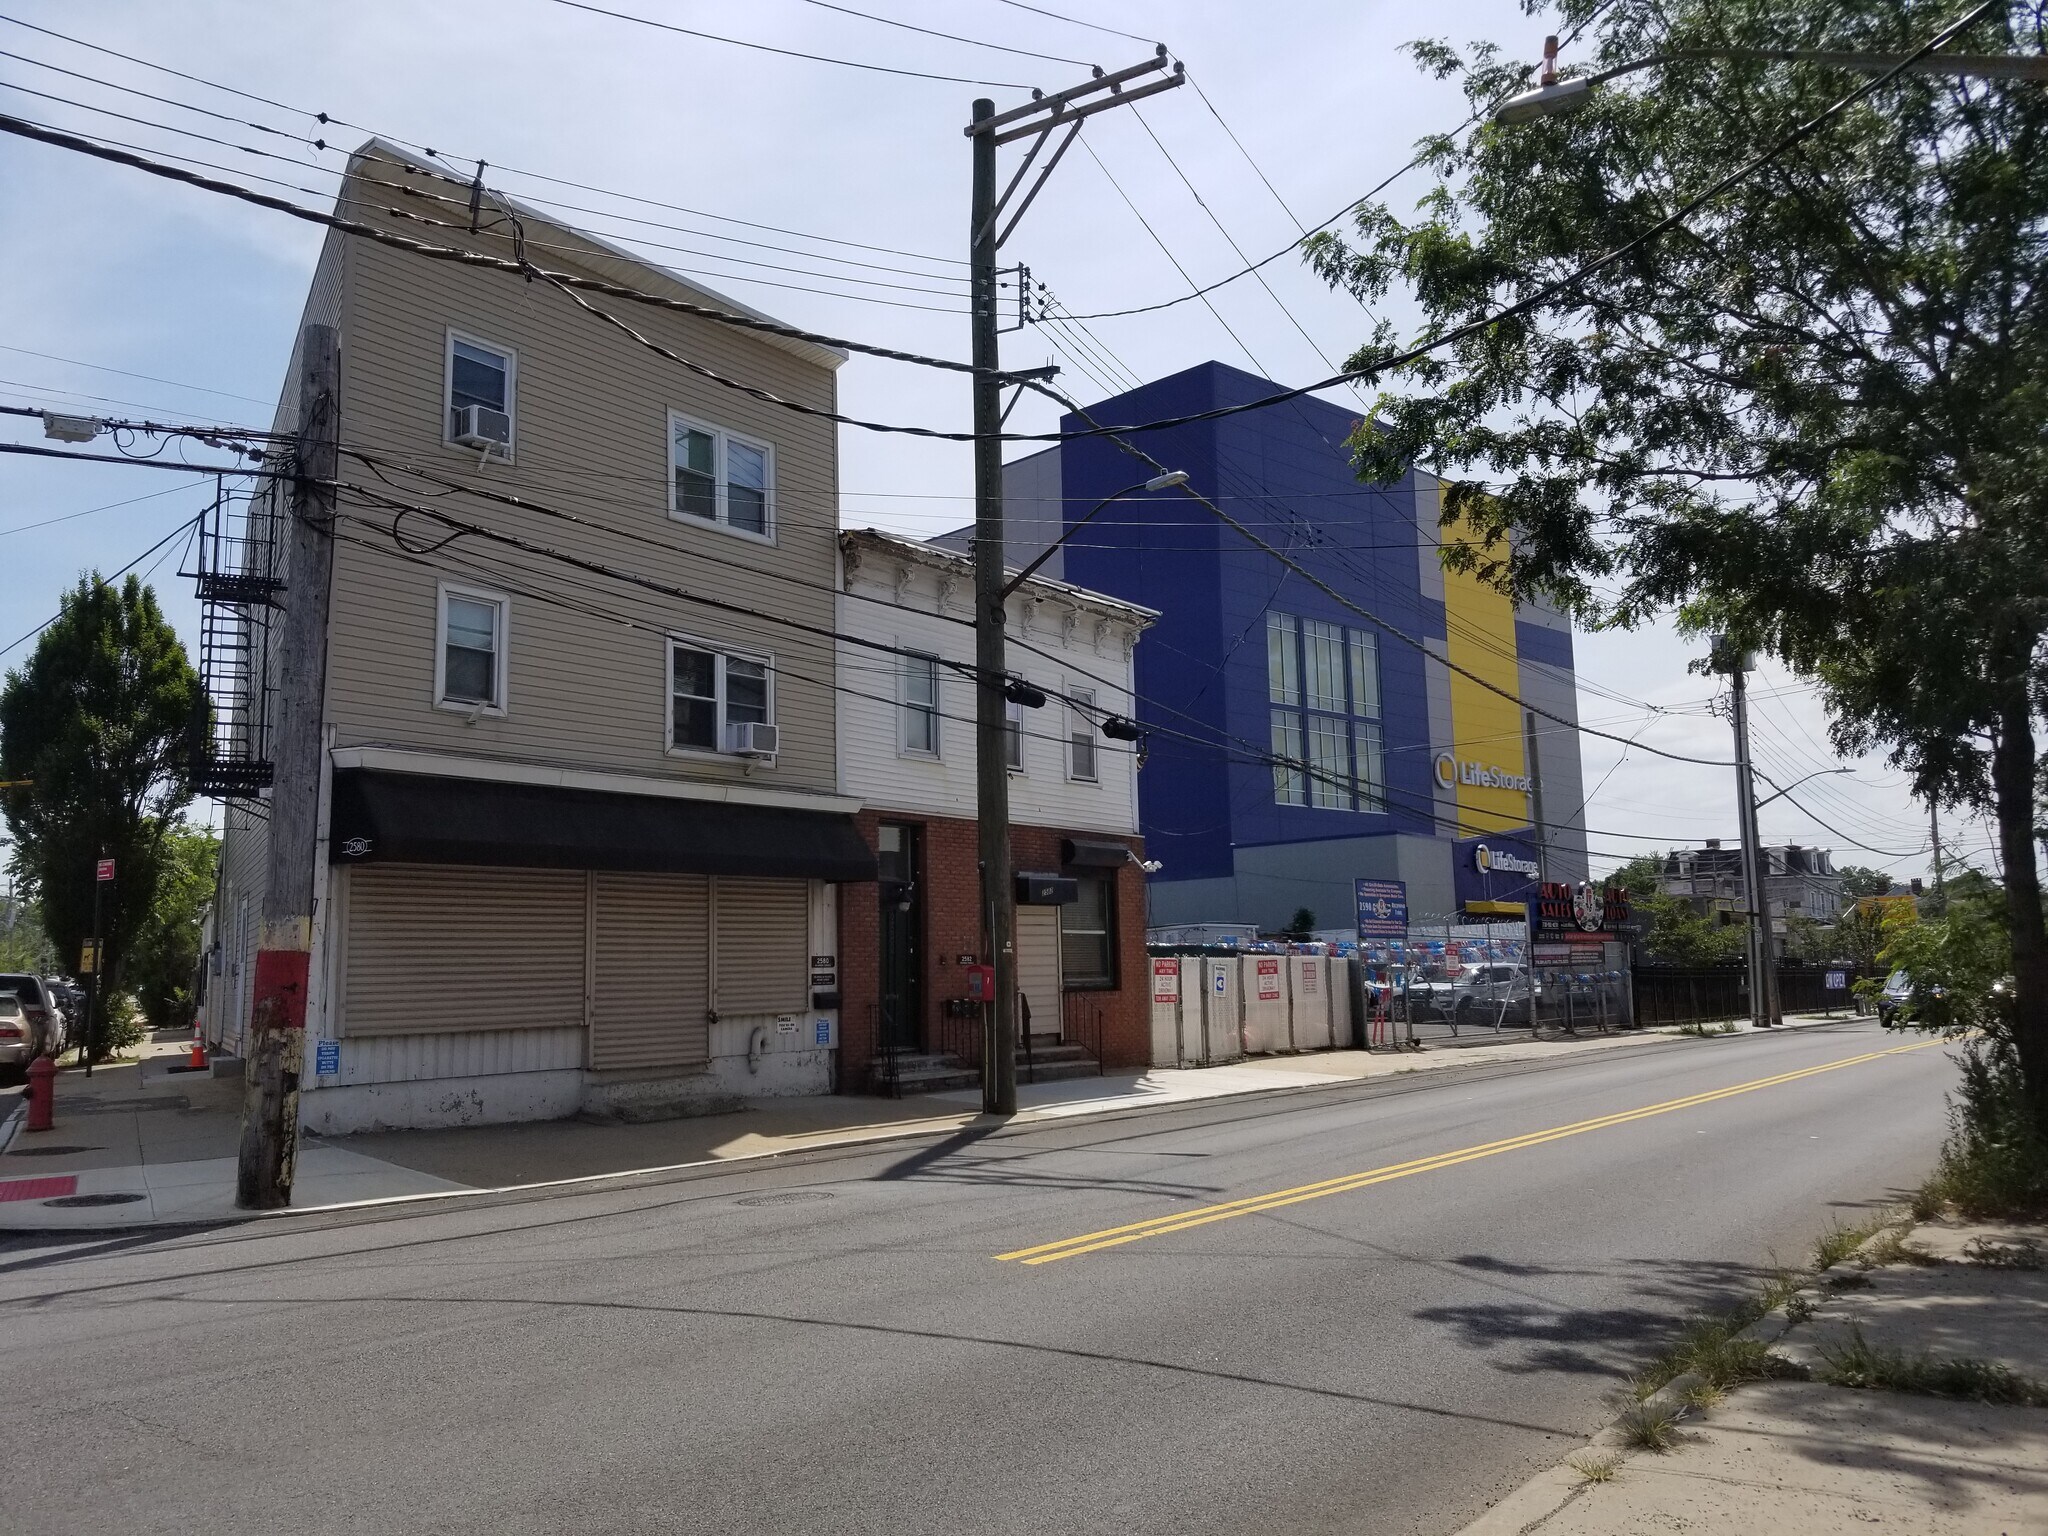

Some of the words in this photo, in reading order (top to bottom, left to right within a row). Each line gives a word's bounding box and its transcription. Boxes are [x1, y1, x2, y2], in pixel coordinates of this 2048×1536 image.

[1461, 761, 1543, 797] LifeStorag
[350, 842, 365, 851] 2580
[1541, 882, 1572, 899] AUTO
[1541, 902, 1572, 918] SALES
